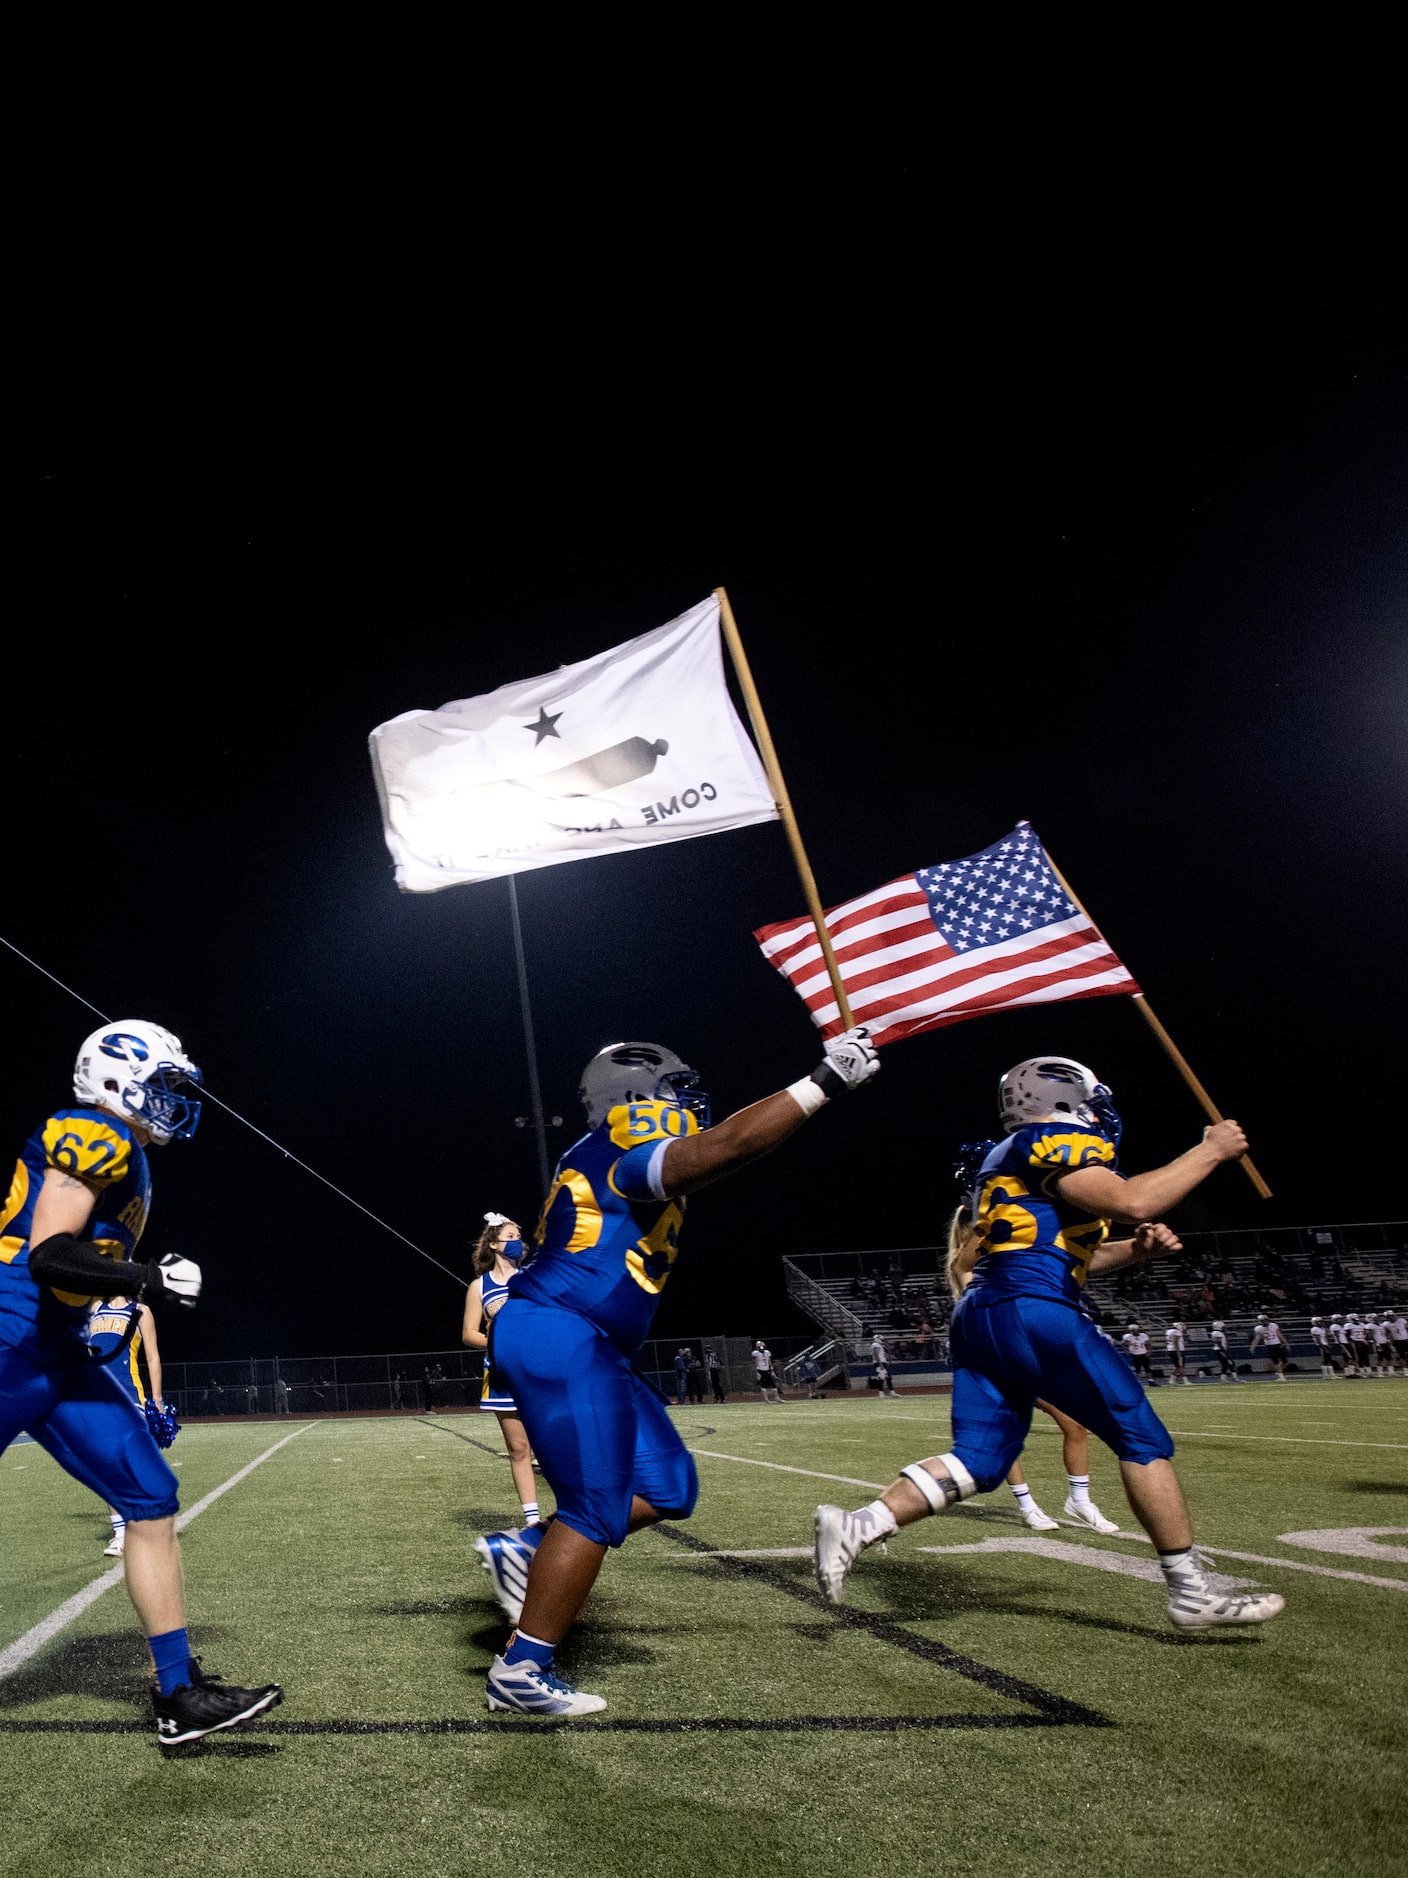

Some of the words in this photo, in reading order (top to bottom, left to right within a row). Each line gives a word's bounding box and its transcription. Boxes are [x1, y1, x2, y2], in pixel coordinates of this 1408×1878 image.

[627, 1103, 688, 1137] 50
[53, 1132, 116, 1176] 62
[977, 1175, 1036, 1254] 6
